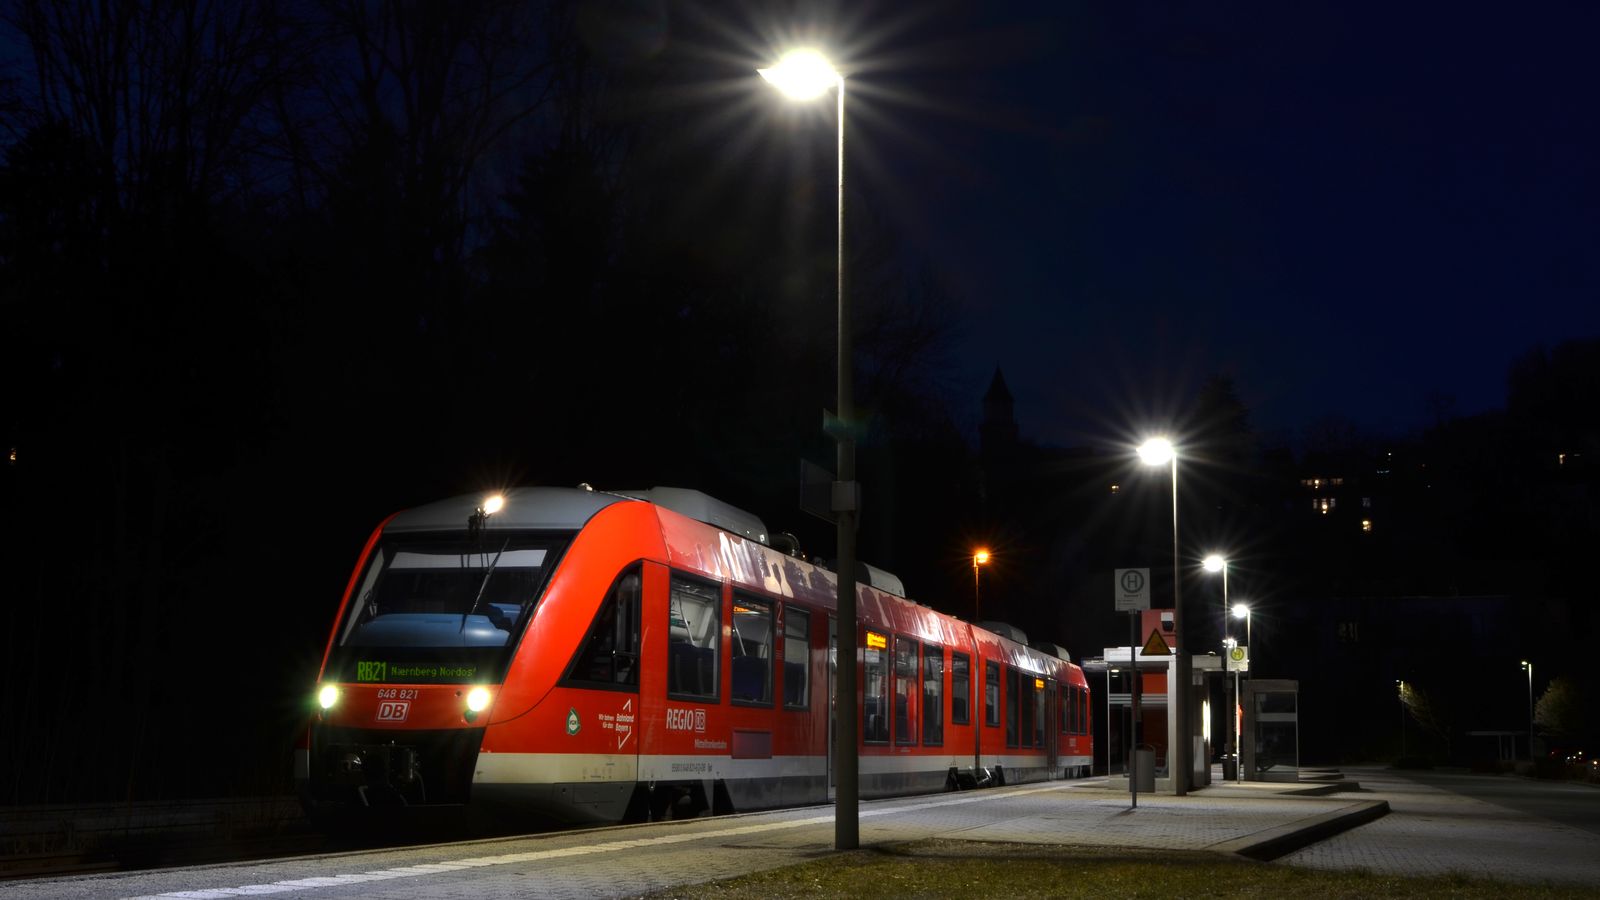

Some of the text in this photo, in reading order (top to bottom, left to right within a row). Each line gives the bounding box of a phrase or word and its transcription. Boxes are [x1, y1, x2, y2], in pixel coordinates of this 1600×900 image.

[1127, 575, 1138, 588] H
[357, 662, 387, 681] RB21
[377, 689, 418, 699] 648 821
[380, 704, 405, 719] DB
[666, 708, 694, 730] REGIO
